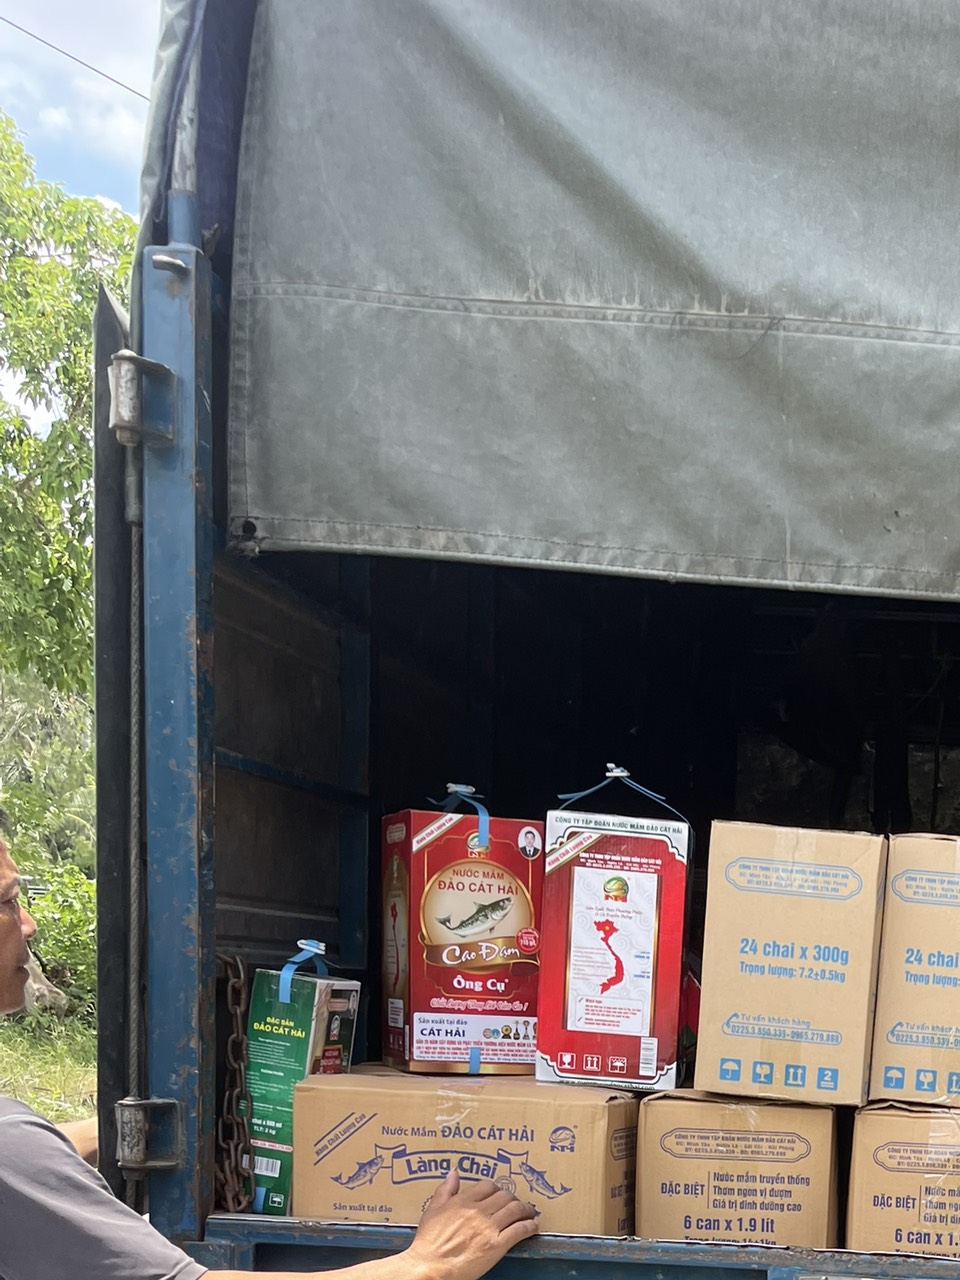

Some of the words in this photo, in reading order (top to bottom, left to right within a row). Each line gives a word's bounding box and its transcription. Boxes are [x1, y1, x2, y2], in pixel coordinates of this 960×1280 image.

[452, 868, 480, 879] NƯỚC
[438, 877, 466, 891] ĐẢO
[468, 880, 494, 894] CÁT
[497, 882, 519, 896] HẢI
[442, 945, 477, 965] Cao
[478, 942, 520, 961] Đạm
[739, 937, 758, 955] 24
[762, 940, 794, 958] chai
[798, 946, 808, 960] x
[812, 944, 849, 966] 300g
[904, 947, 923, 965] 24
[927, 950, 959, 968] chai
[739, 961, 765, 976] Trọng
[767, 964, 796, 978] lượng:
[799, 966, 845, 983] 7.2±0.5kg
[904, 971, 930, 985] Trọng
[931, 973, 960, 987] lượng:
[452, 974, 483, 992] Ông
[486, 979, 506, 993] Cụ
[253, 1021, 272, 1032] ĐẢO
[272, 1025, 290, 1035] CÁT
[291, 1028, 306, 1038] HẢI
[456, 1018, 468, 1026] đảo
[740, 1013, 751, 1022] Tư
[752, 1013, 766, 1023] vấn
[767, 1016, 790, 1026] khách
[791, 1018, 811, 1029] hàng
[420, 1027, 442, 1037] CÁT
[445, 1028, 466, 1038] HẢI
[326, 1134, 341, 1147] Chất
[354, 1112, 367, 1125] Cao
[381, 1125, 408, 1136] Nước
[410, 1126, 437, 1137] Mắm
[440, 1123, 474, 1139] ĐẢO
[477, 1124, 505, 1140] CÁT
[508, 1125, 534, 1142] HẢI
[406, 1154, 452, 1177] Làng
[457, 1155, 499, 1180] Chài
[713, 1171, 734, 1182] Nước
[736, 1172, 757, 1183] mắm
[759, 1173, 785, 1185] truyền
[786, 1173, 810, 1186] thống
[660, 1181, 680, 1197] ĐẶC
[683, 1183, 705, 1198] BIỆT
[712, 1184, 735, 1196] Thơm
[736, 1187, 757, 1198] ngon
[759, 1187, 767, 1199] vị
[768, 1187, 792, 1200] đượm
[332, 1202, 347, 1210] Sản
[348, 1203, 365, 1211] xuất
[366, 1204, 377, 1213] tại
[378, 1204, 392, 1212] đảo
[712, 1198, 726, 1208] Giá
[728, 1199, 737, 1211] trị
[739, 1199, 757, 1210] dinh
[759, 1200, 784, 1212] dưỡng
[786, 1203, 802, 1212] cao
[872, 1193, 892, 1210] ĐẶC
[895, 1194, 916, 1211] BIỆT
[683, 1214, 692, 1229] 6
[695, 1217, 720, 1230] can
[724, 1219, 732, 1231] x
[736, 1217, 756, 1232] 1.9
[760, 1217, 774, 1233] lít
[894, 1228, 902, 1242] 6
[906, 1231, 930, 1244] can
[934, 1232, 943, 1245] x
